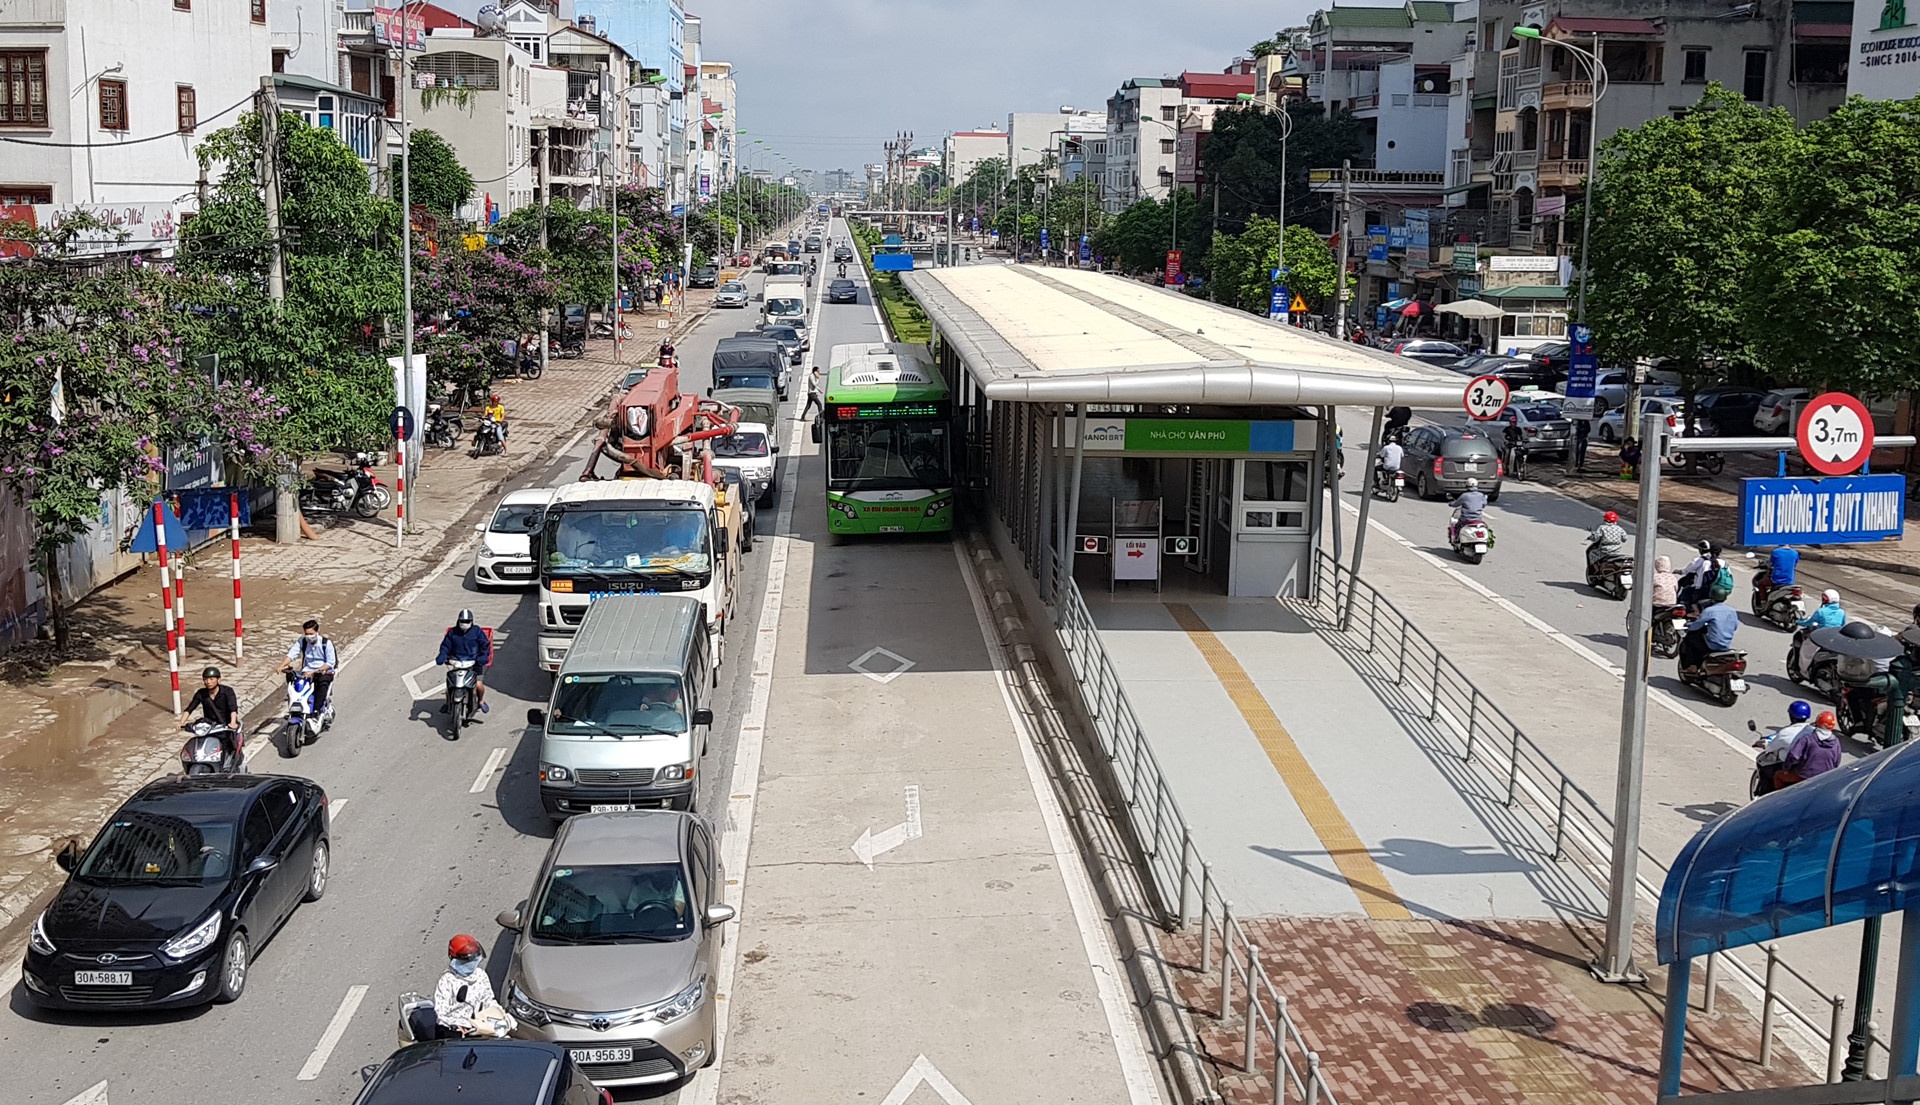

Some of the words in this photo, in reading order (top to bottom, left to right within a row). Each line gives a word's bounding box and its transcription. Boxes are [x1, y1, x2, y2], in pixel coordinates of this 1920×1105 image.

[1471, 387, 1503, 408] 3,2m
[1814, 418, 1858, 446] 3,7m
[1753, 484, 1775, 534] LÀN
[1776, 484, 1813, 534] ĐƯỜNG
[1814, 493, 1830, 533] XE
[1862, 491, 1899, 531] NHANH
[608, 582, 644, 590] ISUZU
[76, 972, 130, 984] 30A-588.17
[571, 1048, 631, 1062] 30A-956.39
